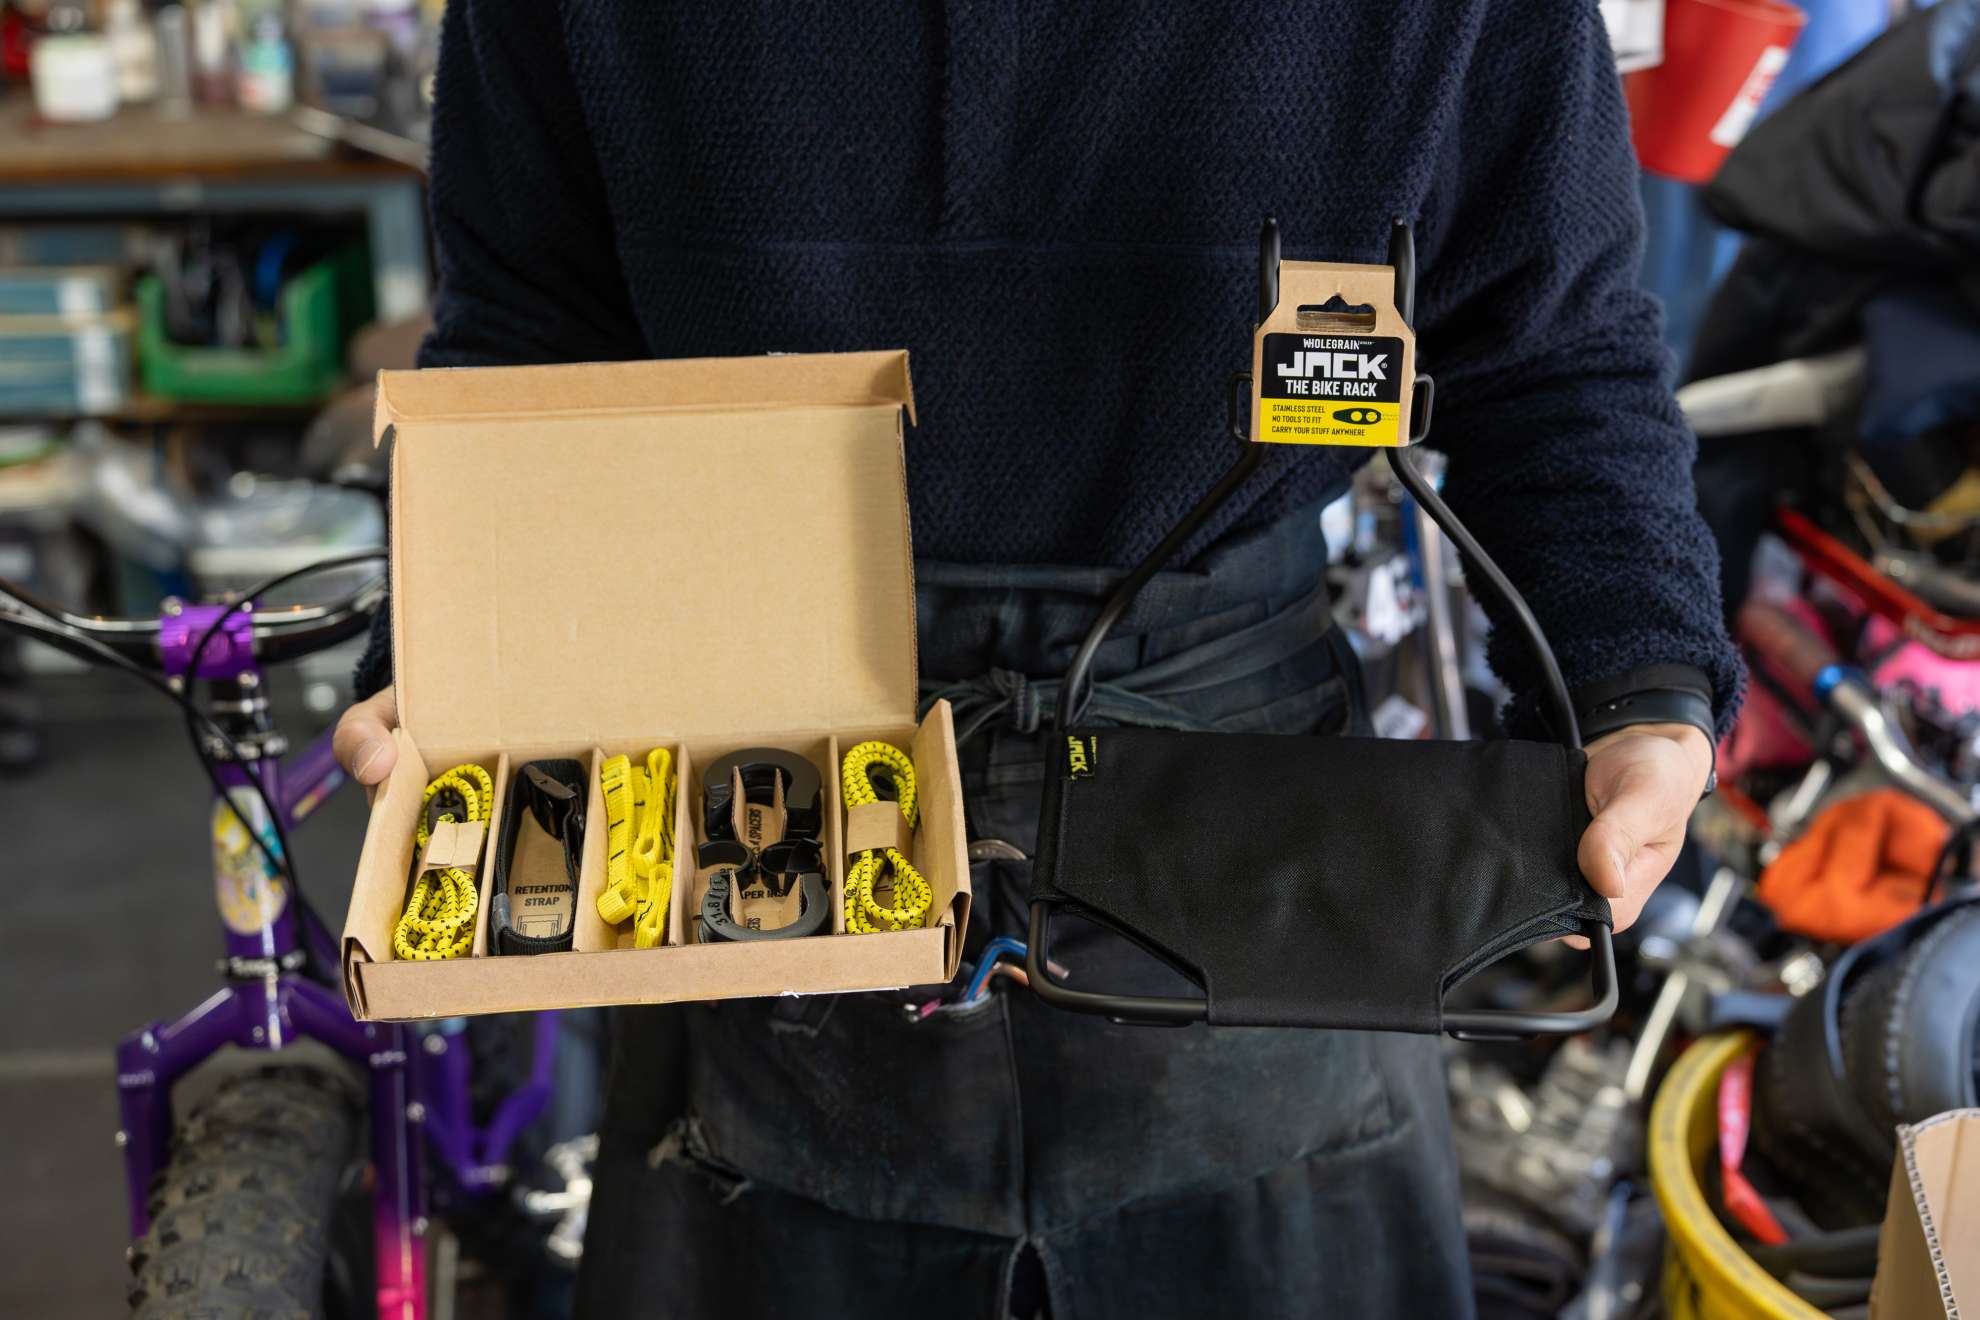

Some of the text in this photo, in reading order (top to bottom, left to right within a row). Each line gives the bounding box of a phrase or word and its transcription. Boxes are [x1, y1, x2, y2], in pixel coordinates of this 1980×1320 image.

[1303, 338, 1360, 350] WHOLEGRAIN
[1286, 379, 1378, 397] THE BIKE RACK
[1272, 404, 1326, 414] STAINLESS STEEL
[1272, 415, 1322, 424] NO TOOLS TO FIT
[1272, 425, 1366, 437] CARRY YOUR STUFF ANYWHERE
[515, 884, 572, 895] RETENTION
[524, 896, 560, 907] STRAP
